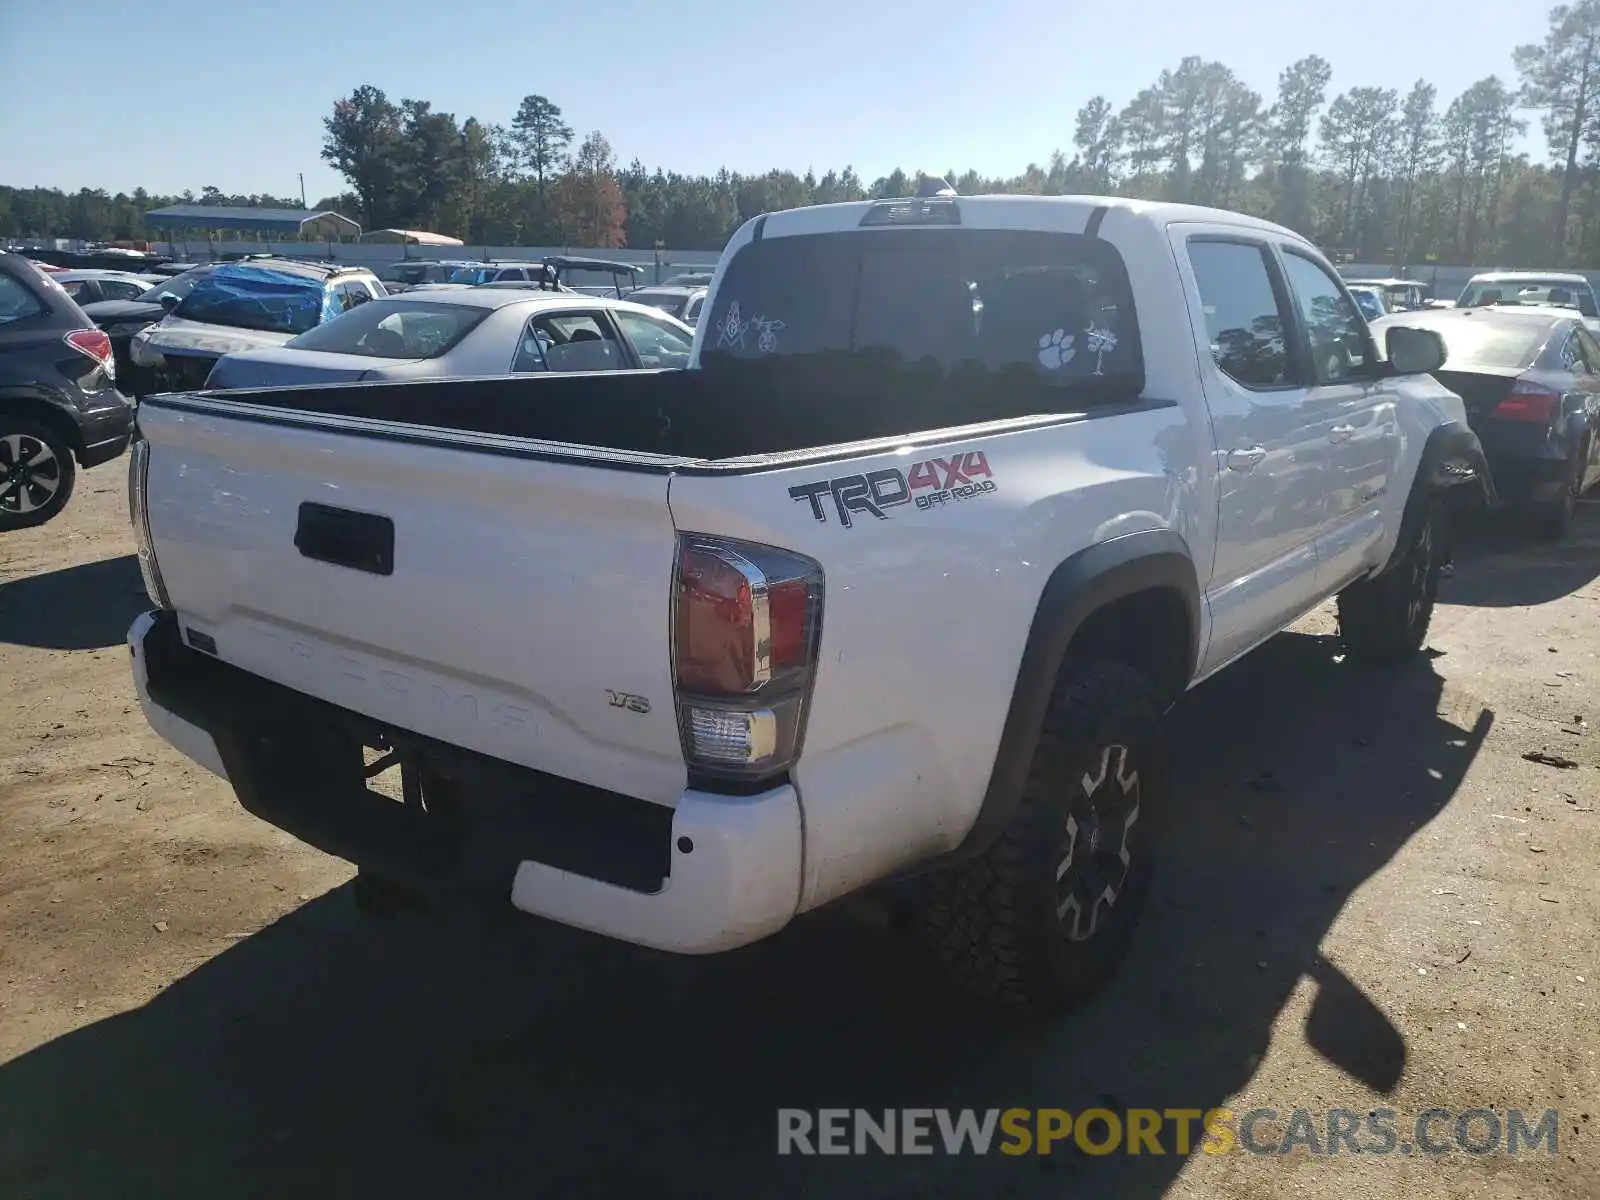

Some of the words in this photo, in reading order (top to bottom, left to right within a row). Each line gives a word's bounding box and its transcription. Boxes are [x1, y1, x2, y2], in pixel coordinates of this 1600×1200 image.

[788, 467, 913, 529] TRD
[915, 488, 951, 511] OFF
[951, 479, 998, 501] ROAD
[604, 688, 652, 714] V6
